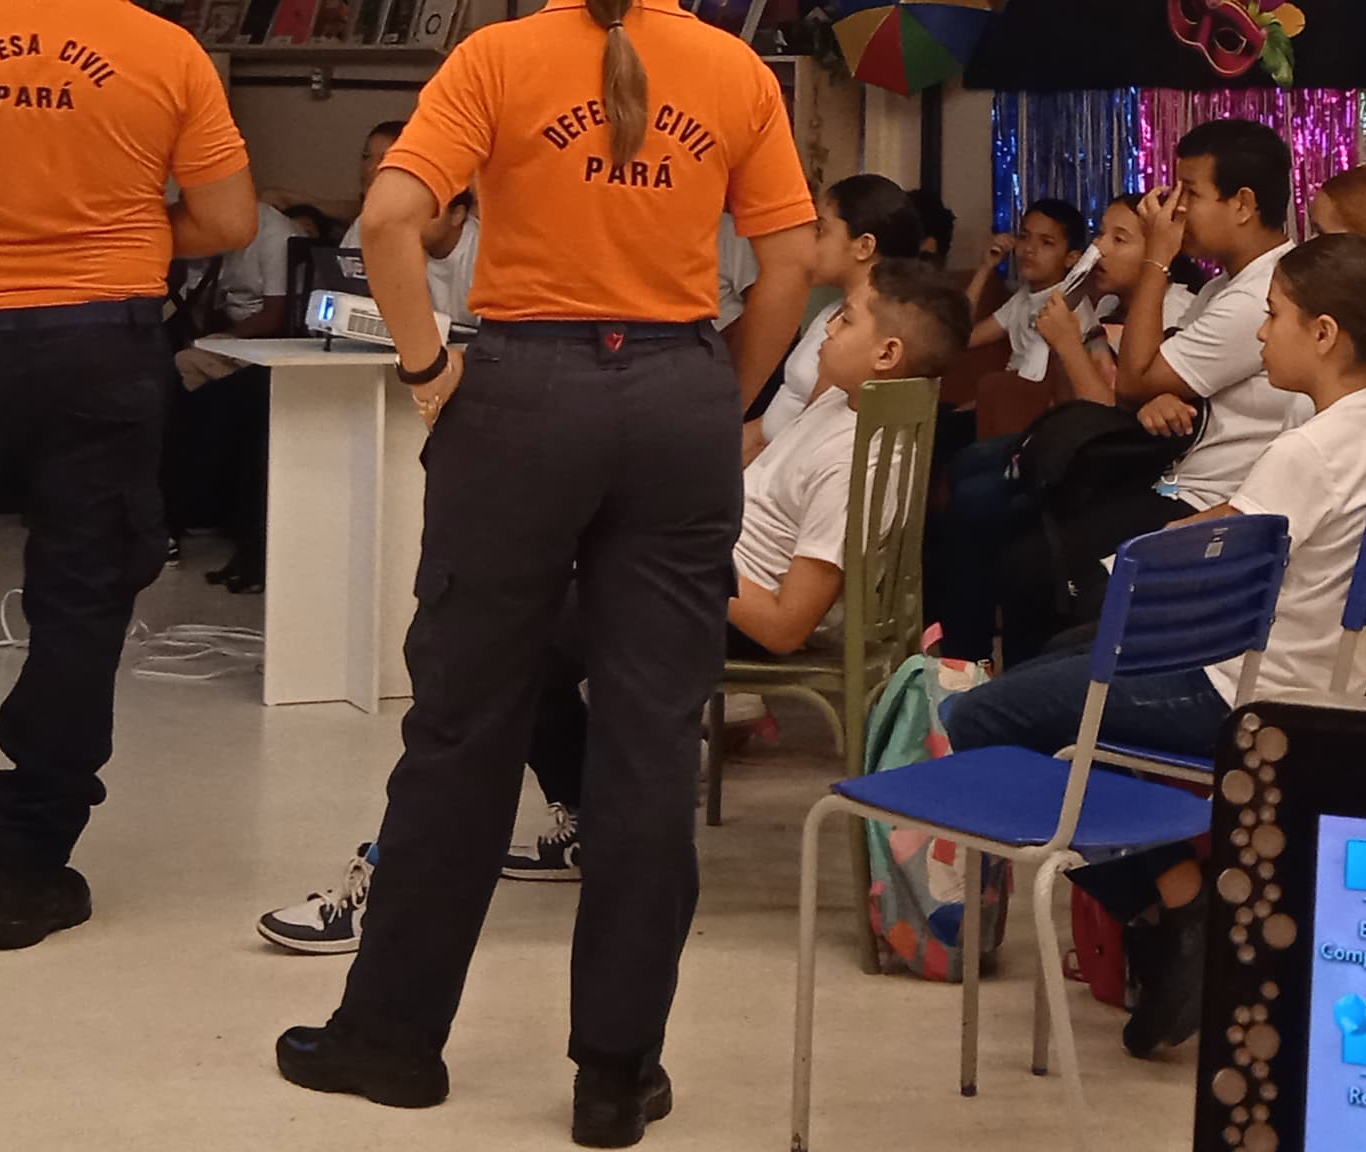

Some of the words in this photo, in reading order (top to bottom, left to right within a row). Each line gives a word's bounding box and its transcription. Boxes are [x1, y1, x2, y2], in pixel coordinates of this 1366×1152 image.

[58, 39, 116, 89] CIVIL
[542, 99, 611, 151] DEFE
[653, 104, 717, 163] CIVIL
[584, 155, 674, 189] PARÁ
